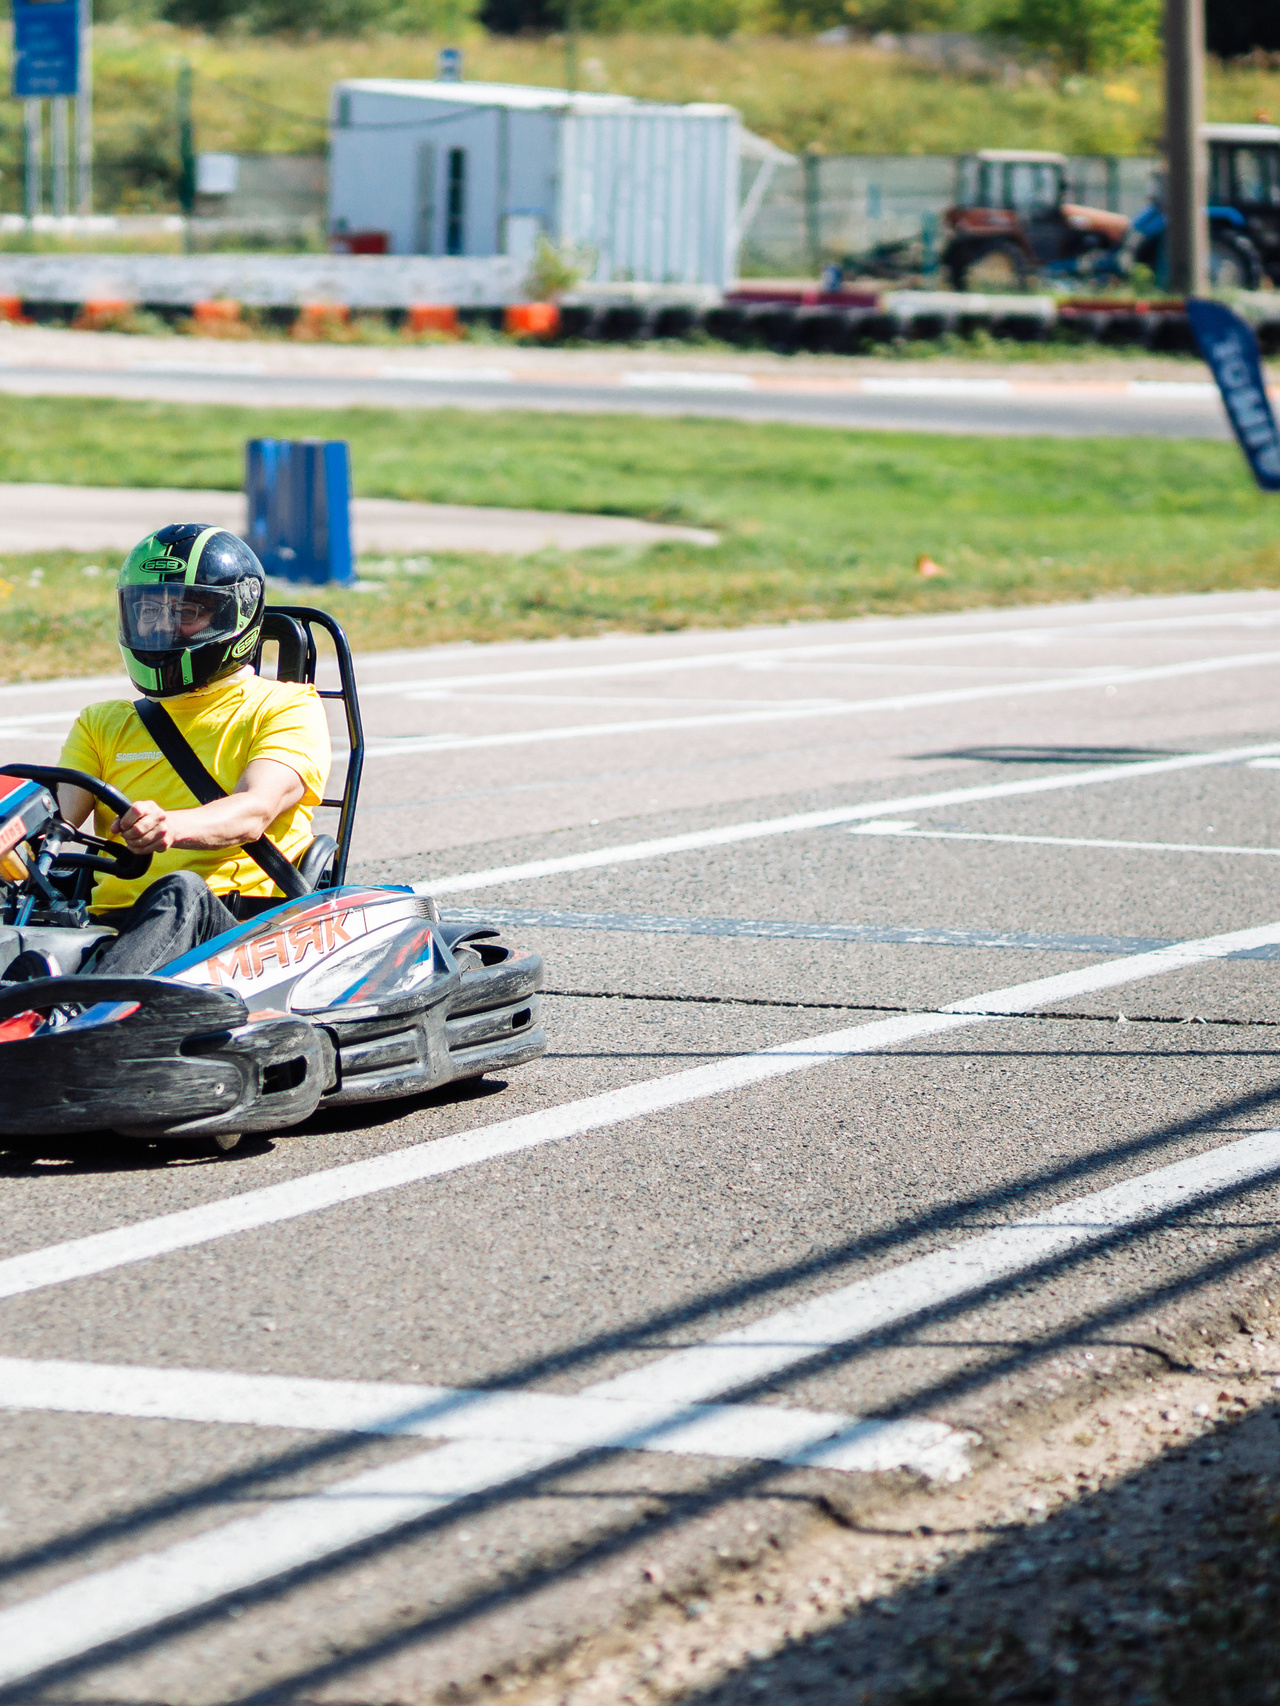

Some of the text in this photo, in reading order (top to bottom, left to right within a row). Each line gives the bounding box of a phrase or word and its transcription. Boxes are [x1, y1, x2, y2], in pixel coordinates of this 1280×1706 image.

[145, 560, 179, 569] GSB
[115, 751, 162, 761] SIEMENS
[206, 908, 352, 985] МАЯК
